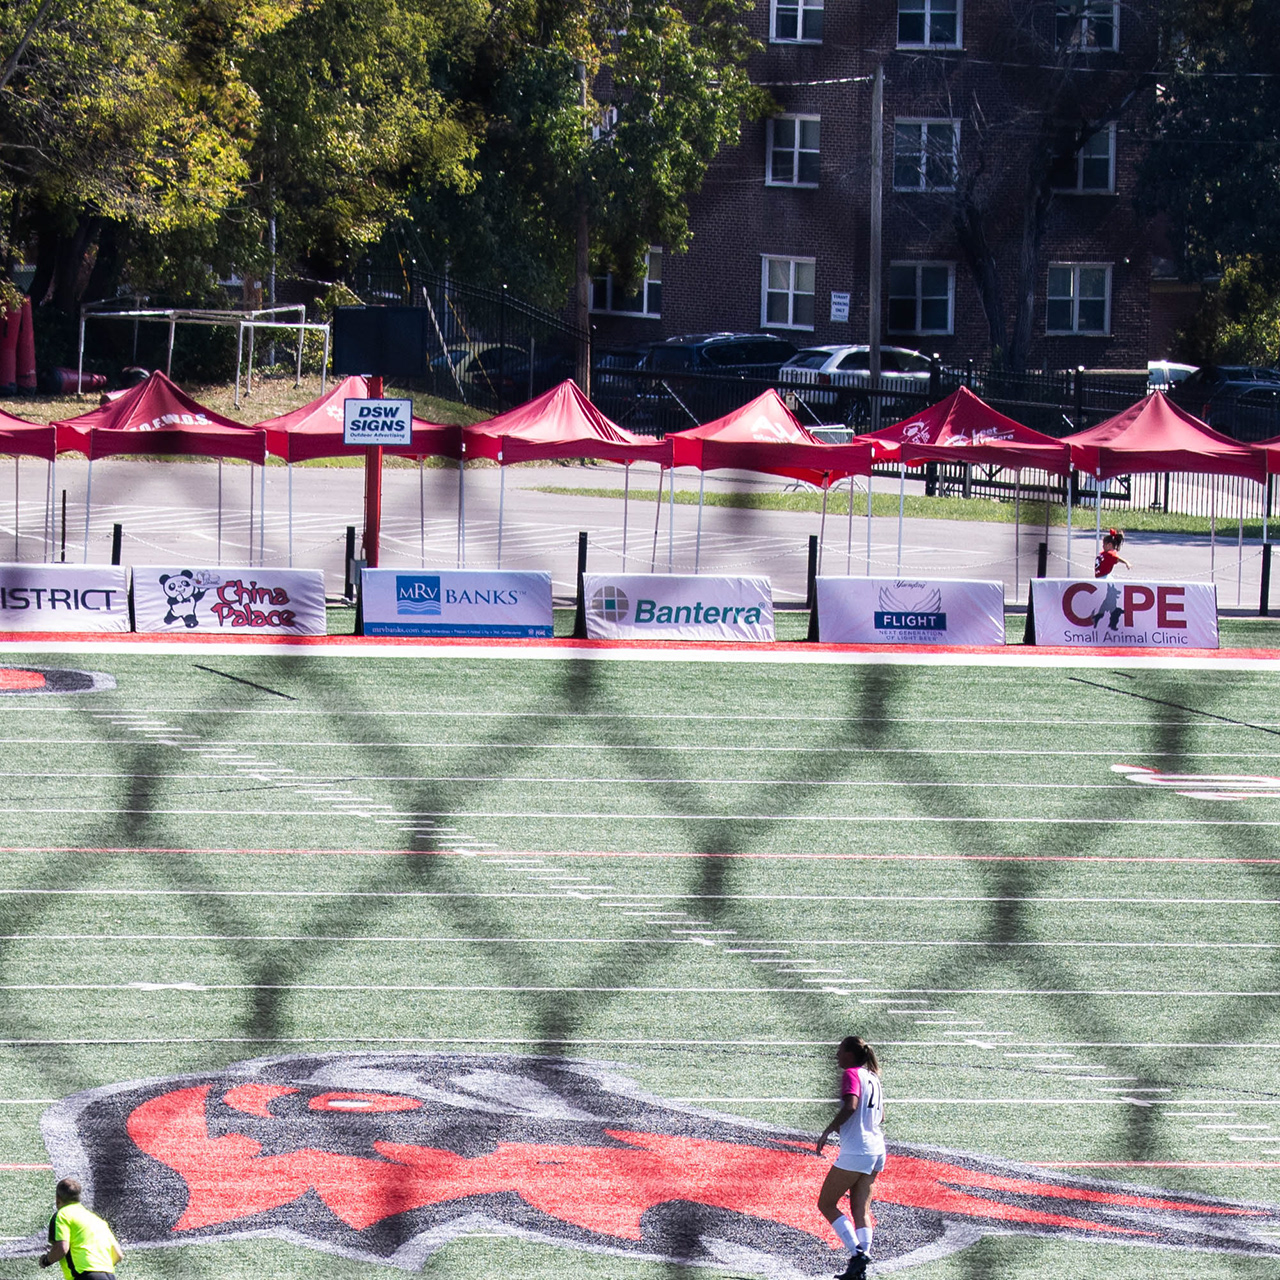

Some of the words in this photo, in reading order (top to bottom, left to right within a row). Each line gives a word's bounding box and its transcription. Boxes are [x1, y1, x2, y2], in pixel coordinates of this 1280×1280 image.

[359, 406, 400, 418] DSW
[350, 420, 405, 431] SIGNS
[216, 580, 290, 605] China
[210, 603, 295, 627] Palace
[883, 615, 937, 627] FLIGHT
[1064, 631, 1098, 643] Small
[1103, 631, 1148, 644] Animal
[1151, 632, 1188, 645] Clinic
